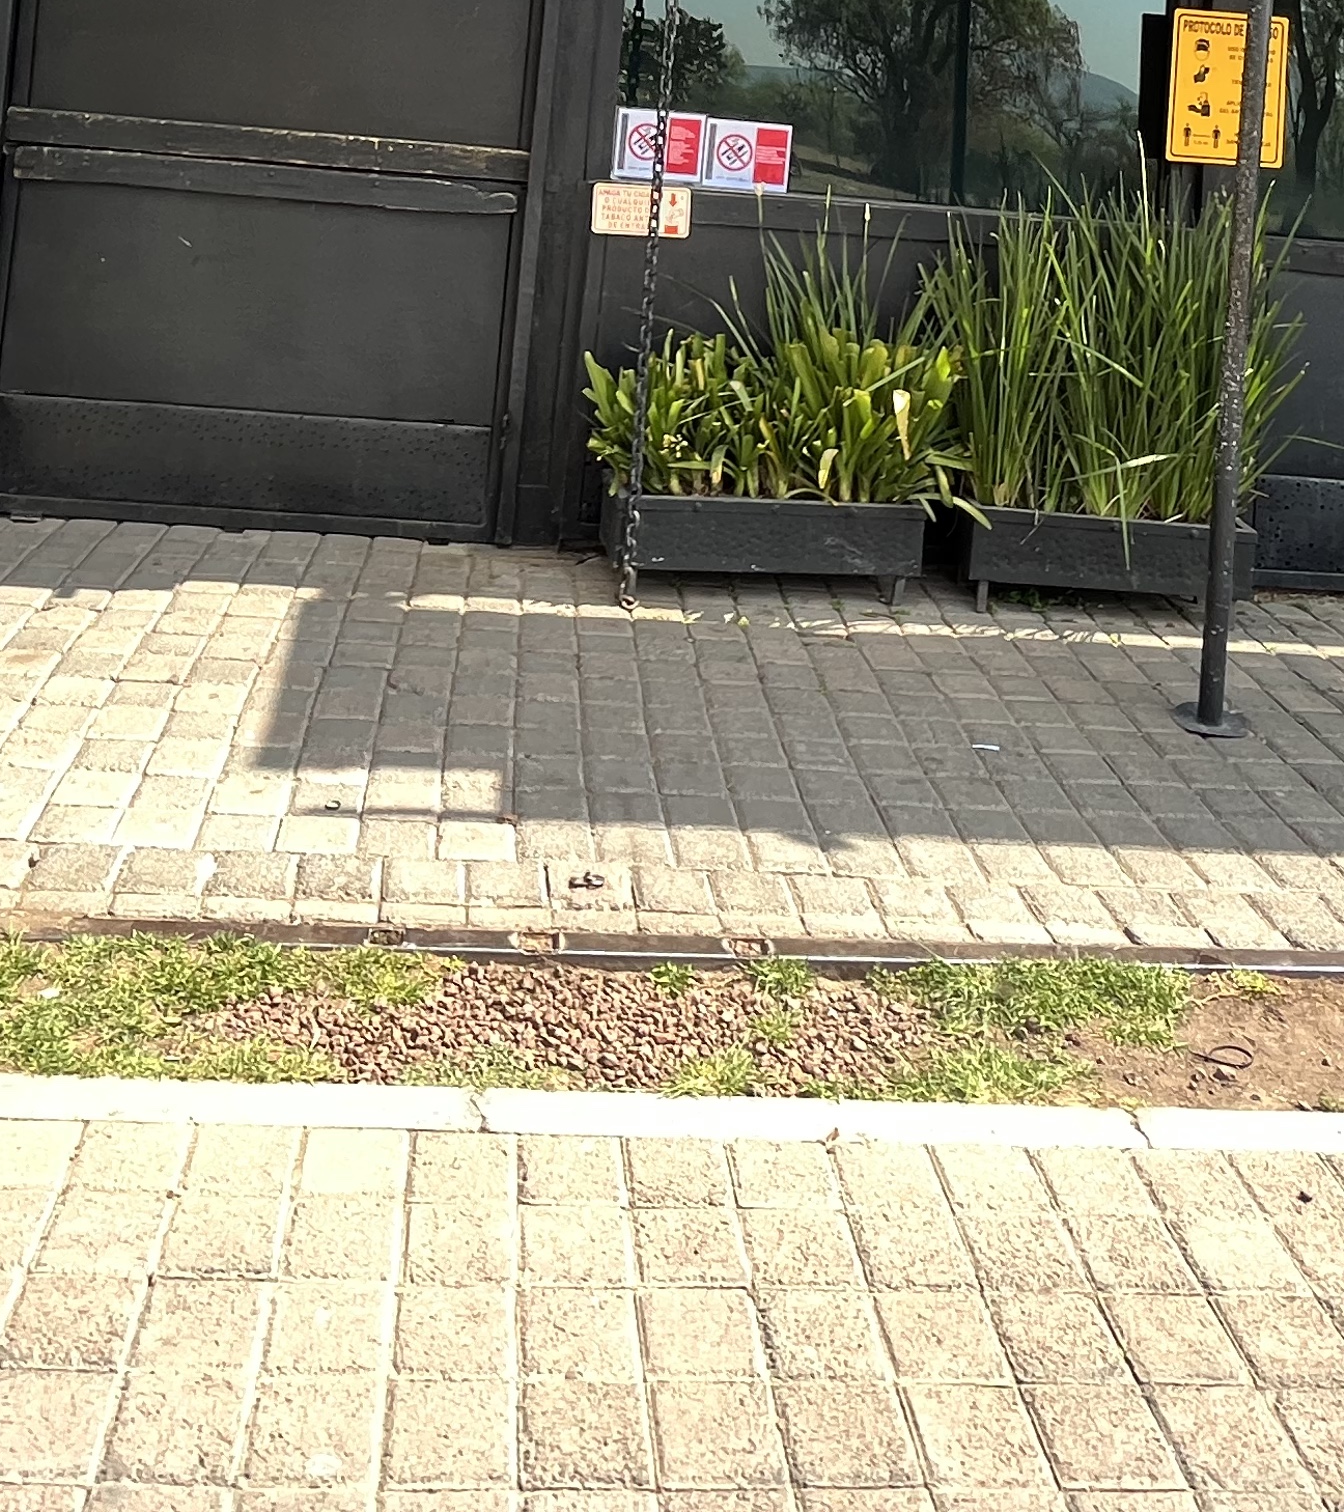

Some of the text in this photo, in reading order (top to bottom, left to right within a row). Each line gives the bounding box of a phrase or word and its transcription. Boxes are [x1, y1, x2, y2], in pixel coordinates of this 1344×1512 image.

[1183, 19, 1244, 37] PROTOCOLO DE
[602, 204, 642, 213] PRODUCTO
[601, 213, 631, 221] TABACO
[620, 222, 646, 230] ENTRA
